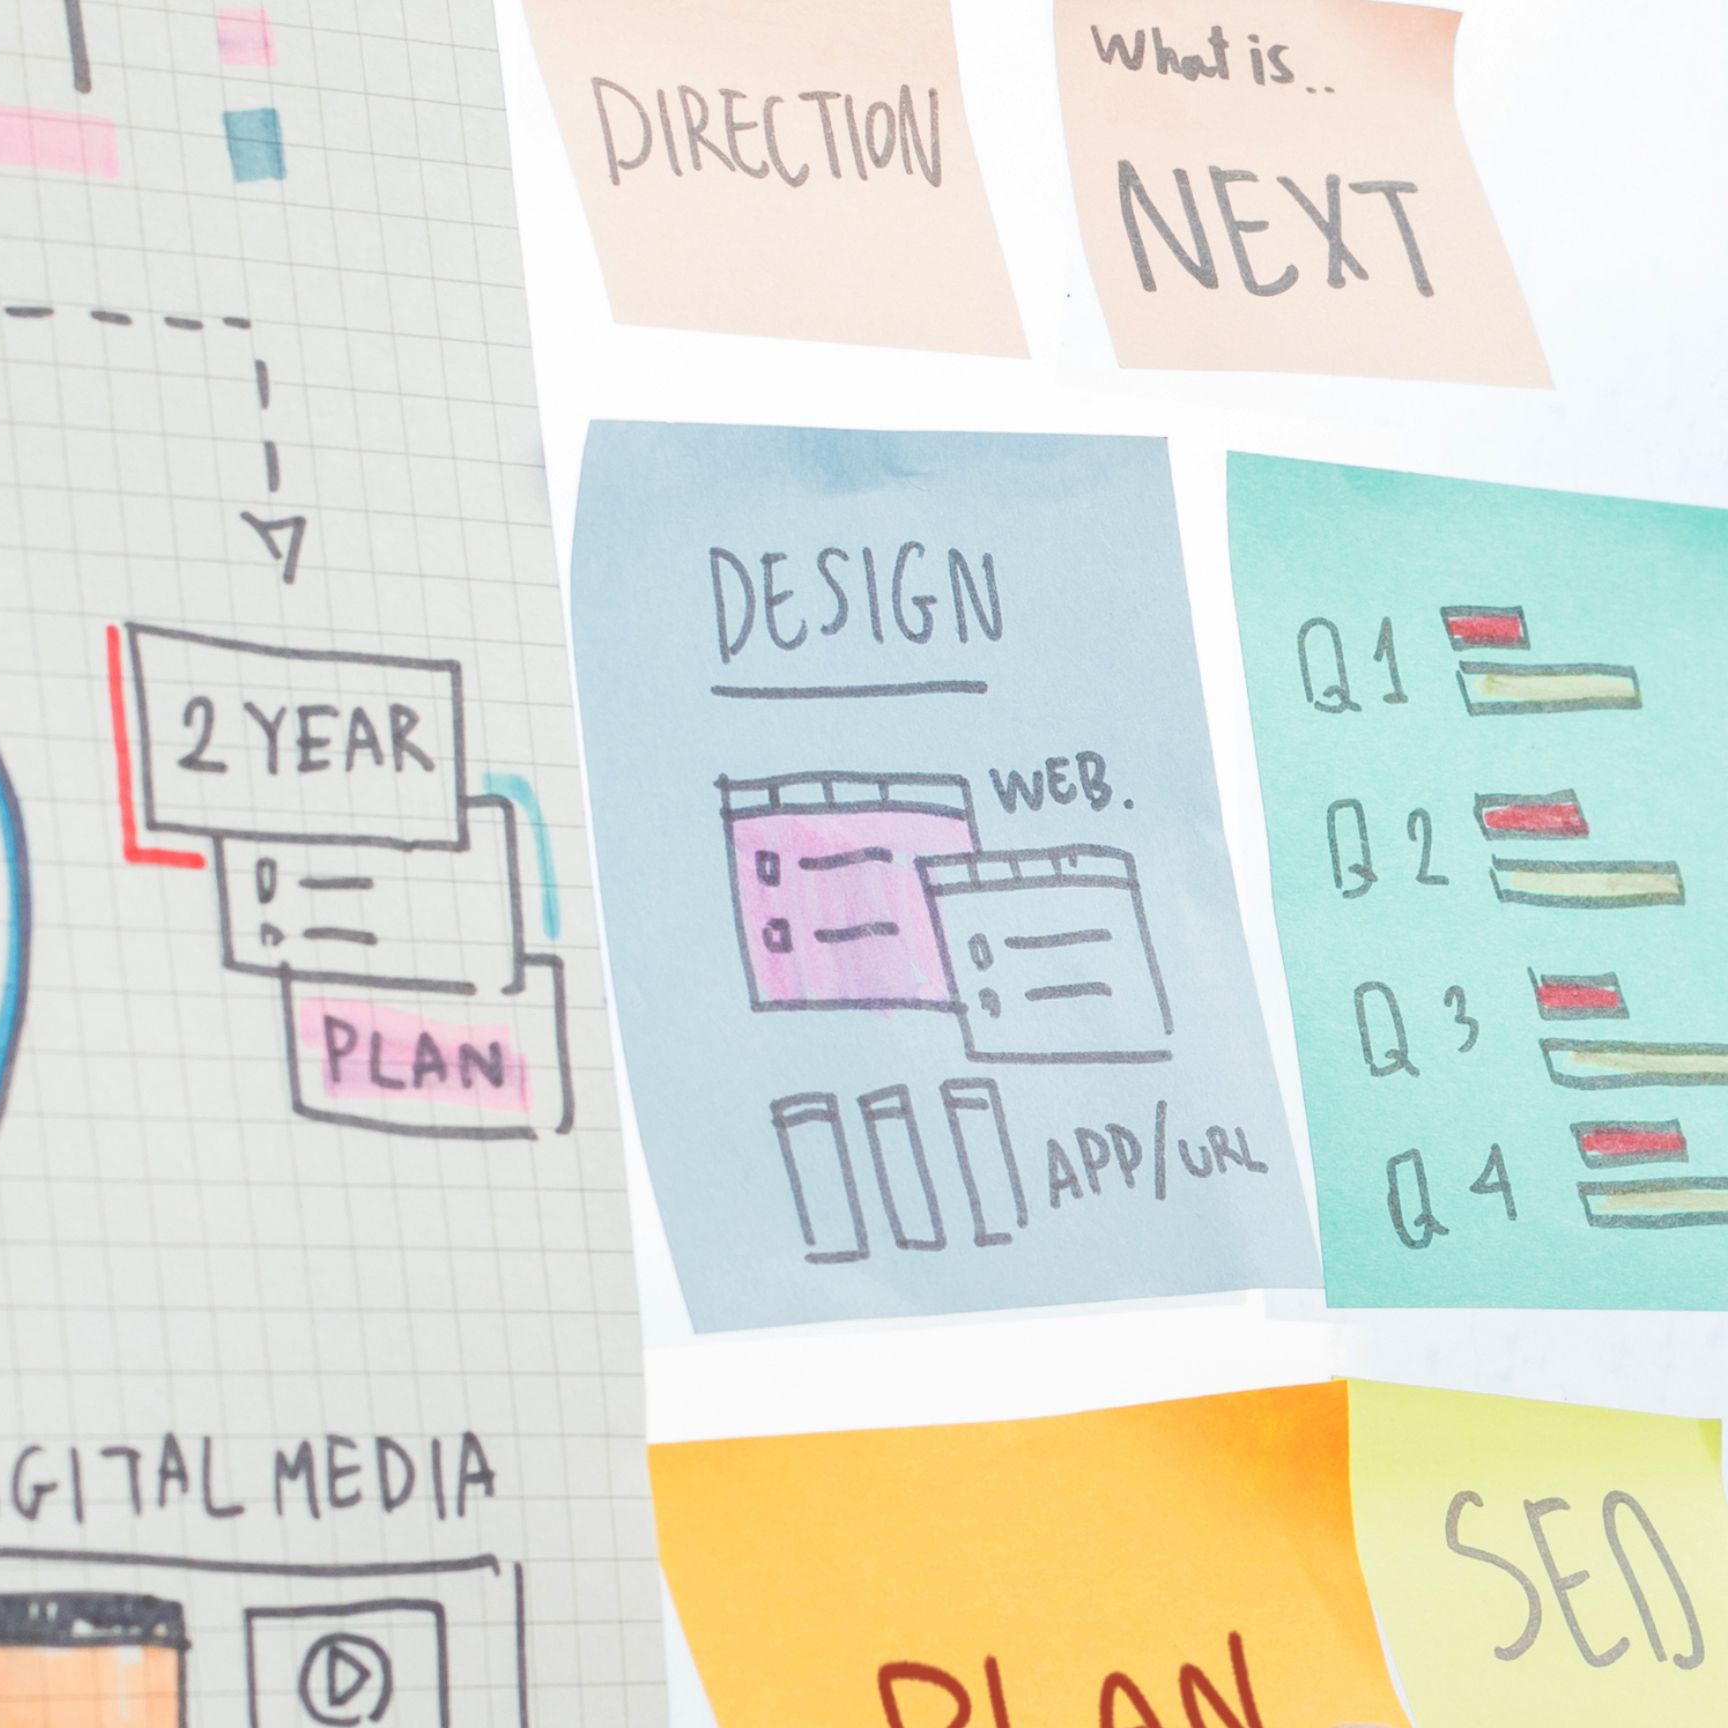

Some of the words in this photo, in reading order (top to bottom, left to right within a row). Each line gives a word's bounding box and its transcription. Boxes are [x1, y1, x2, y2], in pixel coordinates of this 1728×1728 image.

[1090, 24, 1230, 82] What
[592, 77, 942, 188] DIRECTION
[1117, 159, 1435, 298] NEXT
[709, 540, 1003, 665] DESIGN
[177, 695, 228, 774] 2
[243, 701, 435, 776] YEAR
[325, 1016, 502, 1086] PLAN
[274, 1430, 496, 1521] MEDIA
